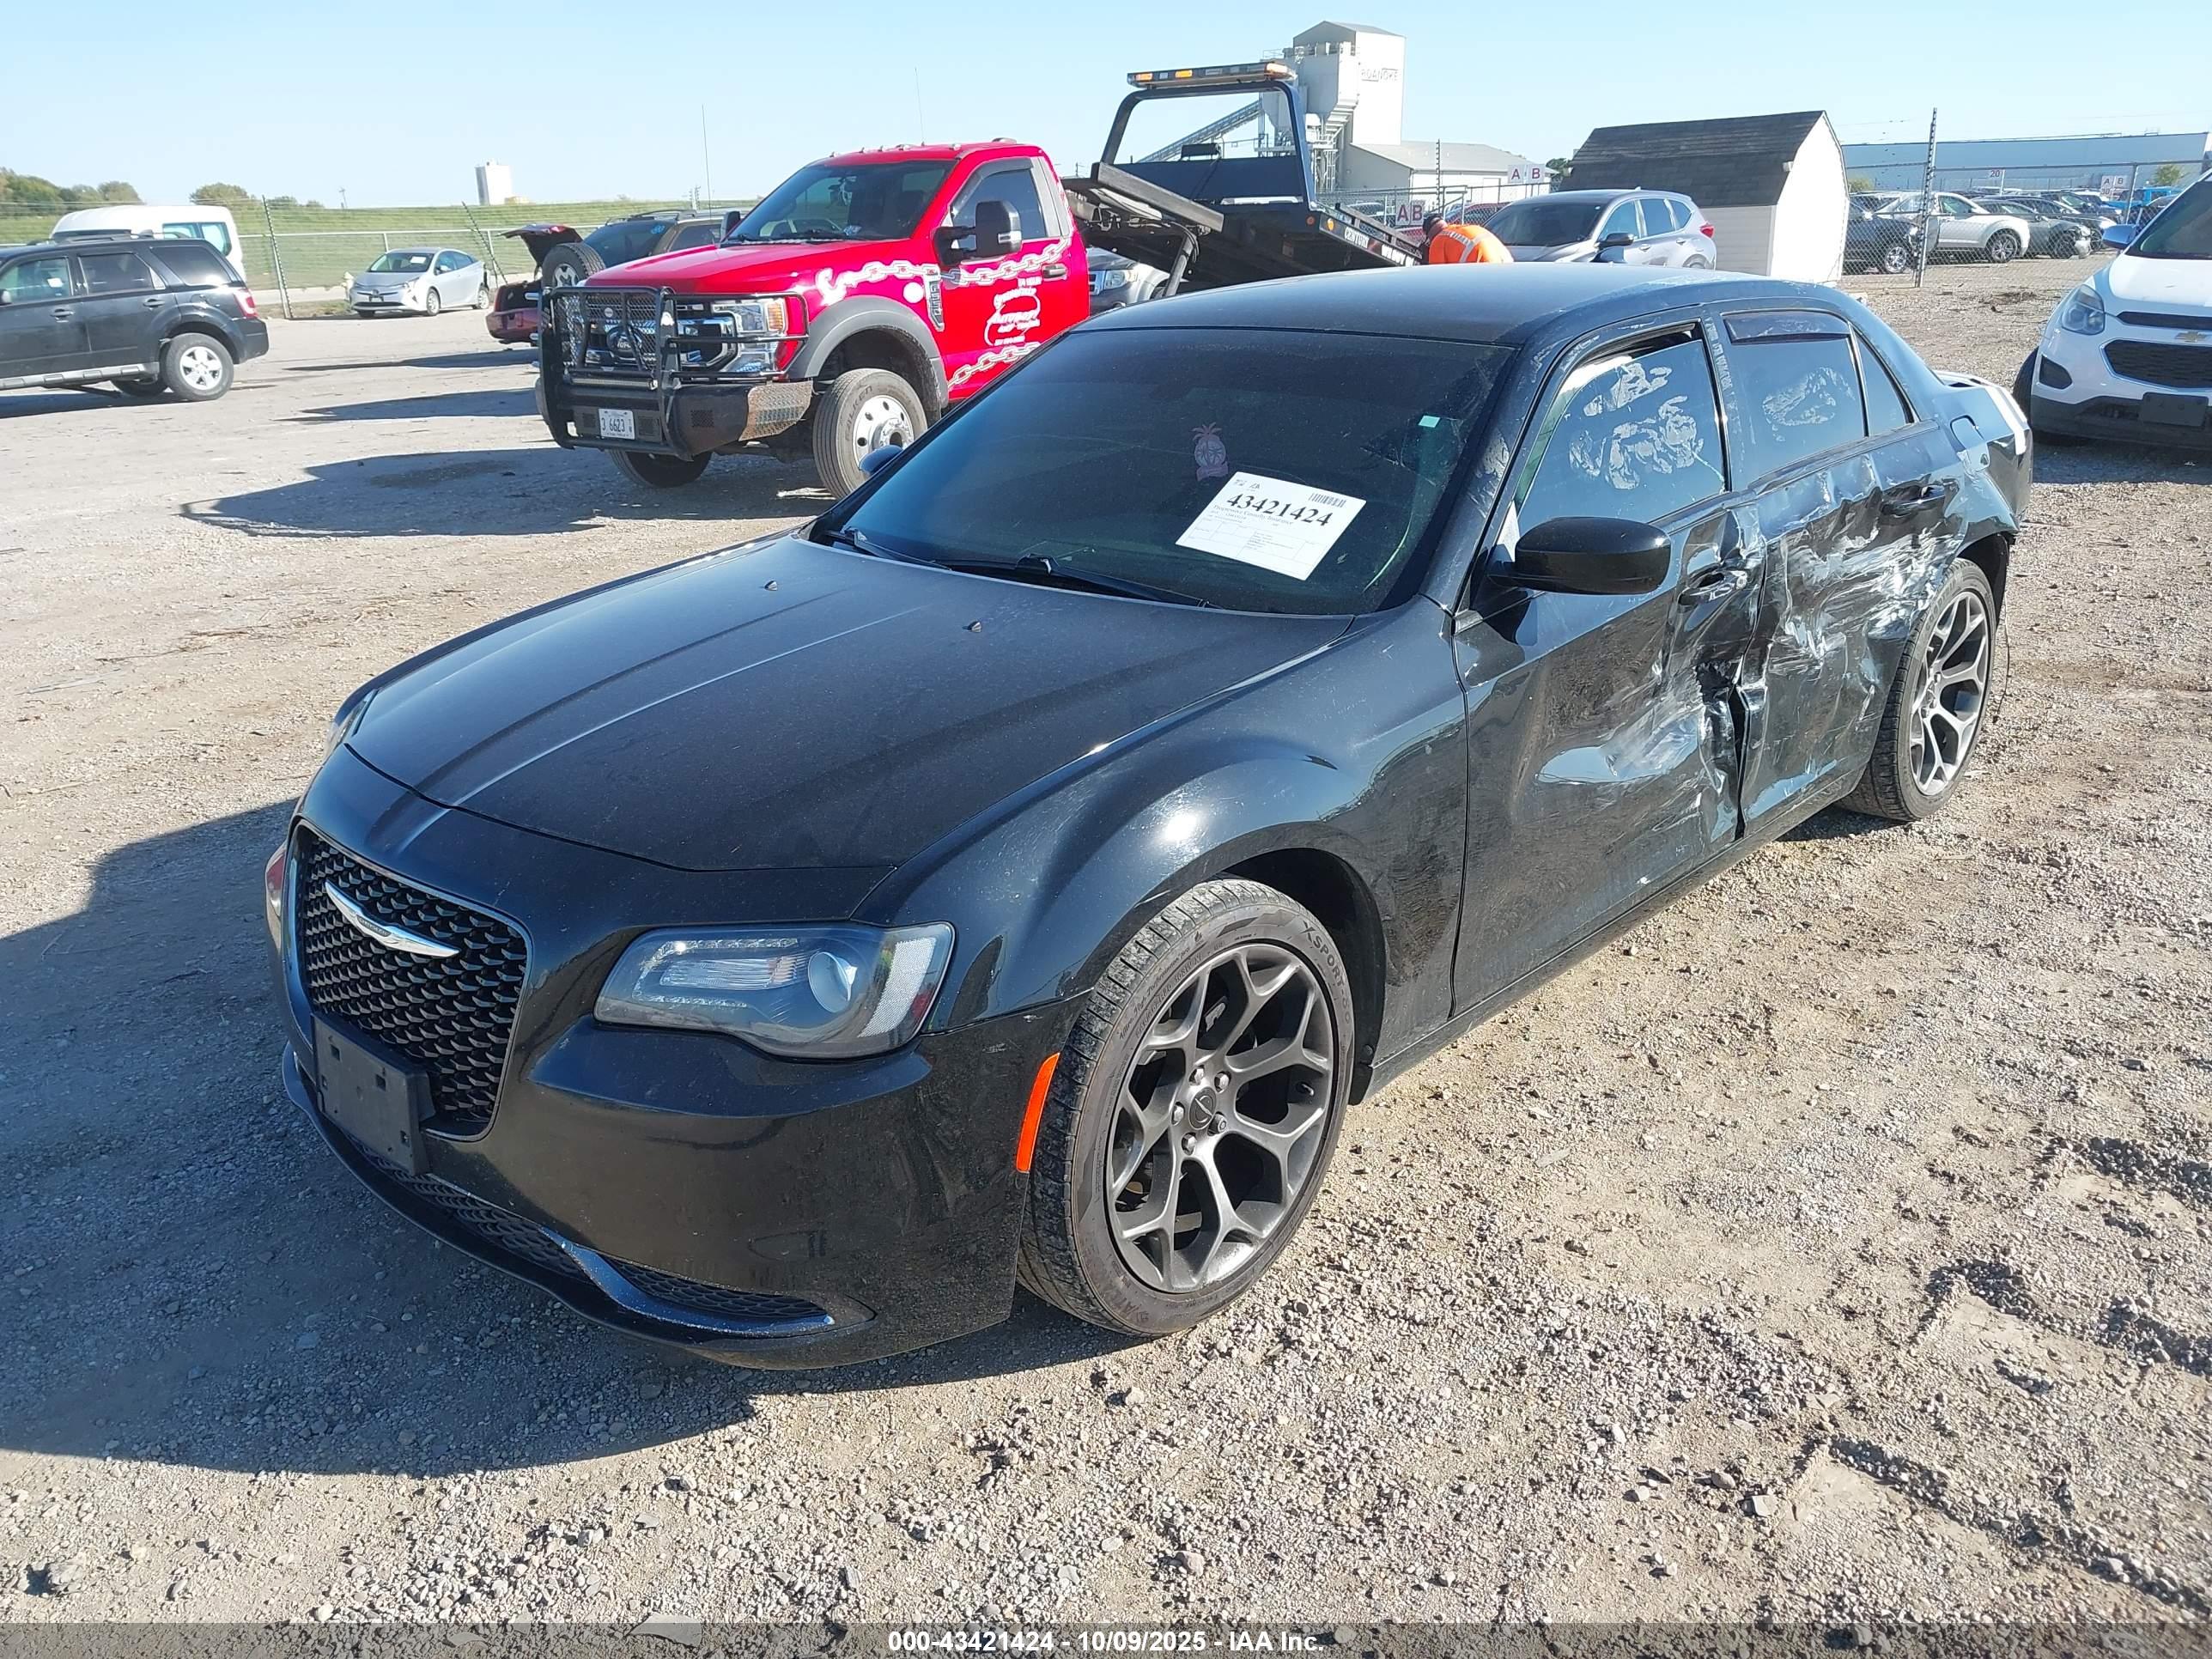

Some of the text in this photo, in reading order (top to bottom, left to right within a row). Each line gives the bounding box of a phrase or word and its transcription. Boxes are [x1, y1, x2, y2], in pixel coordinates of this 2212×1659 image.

[1511, 167, 1540, 179] A B
[1397, 205, 1423, 222] A B
[610, 417, 626, 433] 6623
[1226, 493, 1334, 526] 43421424
